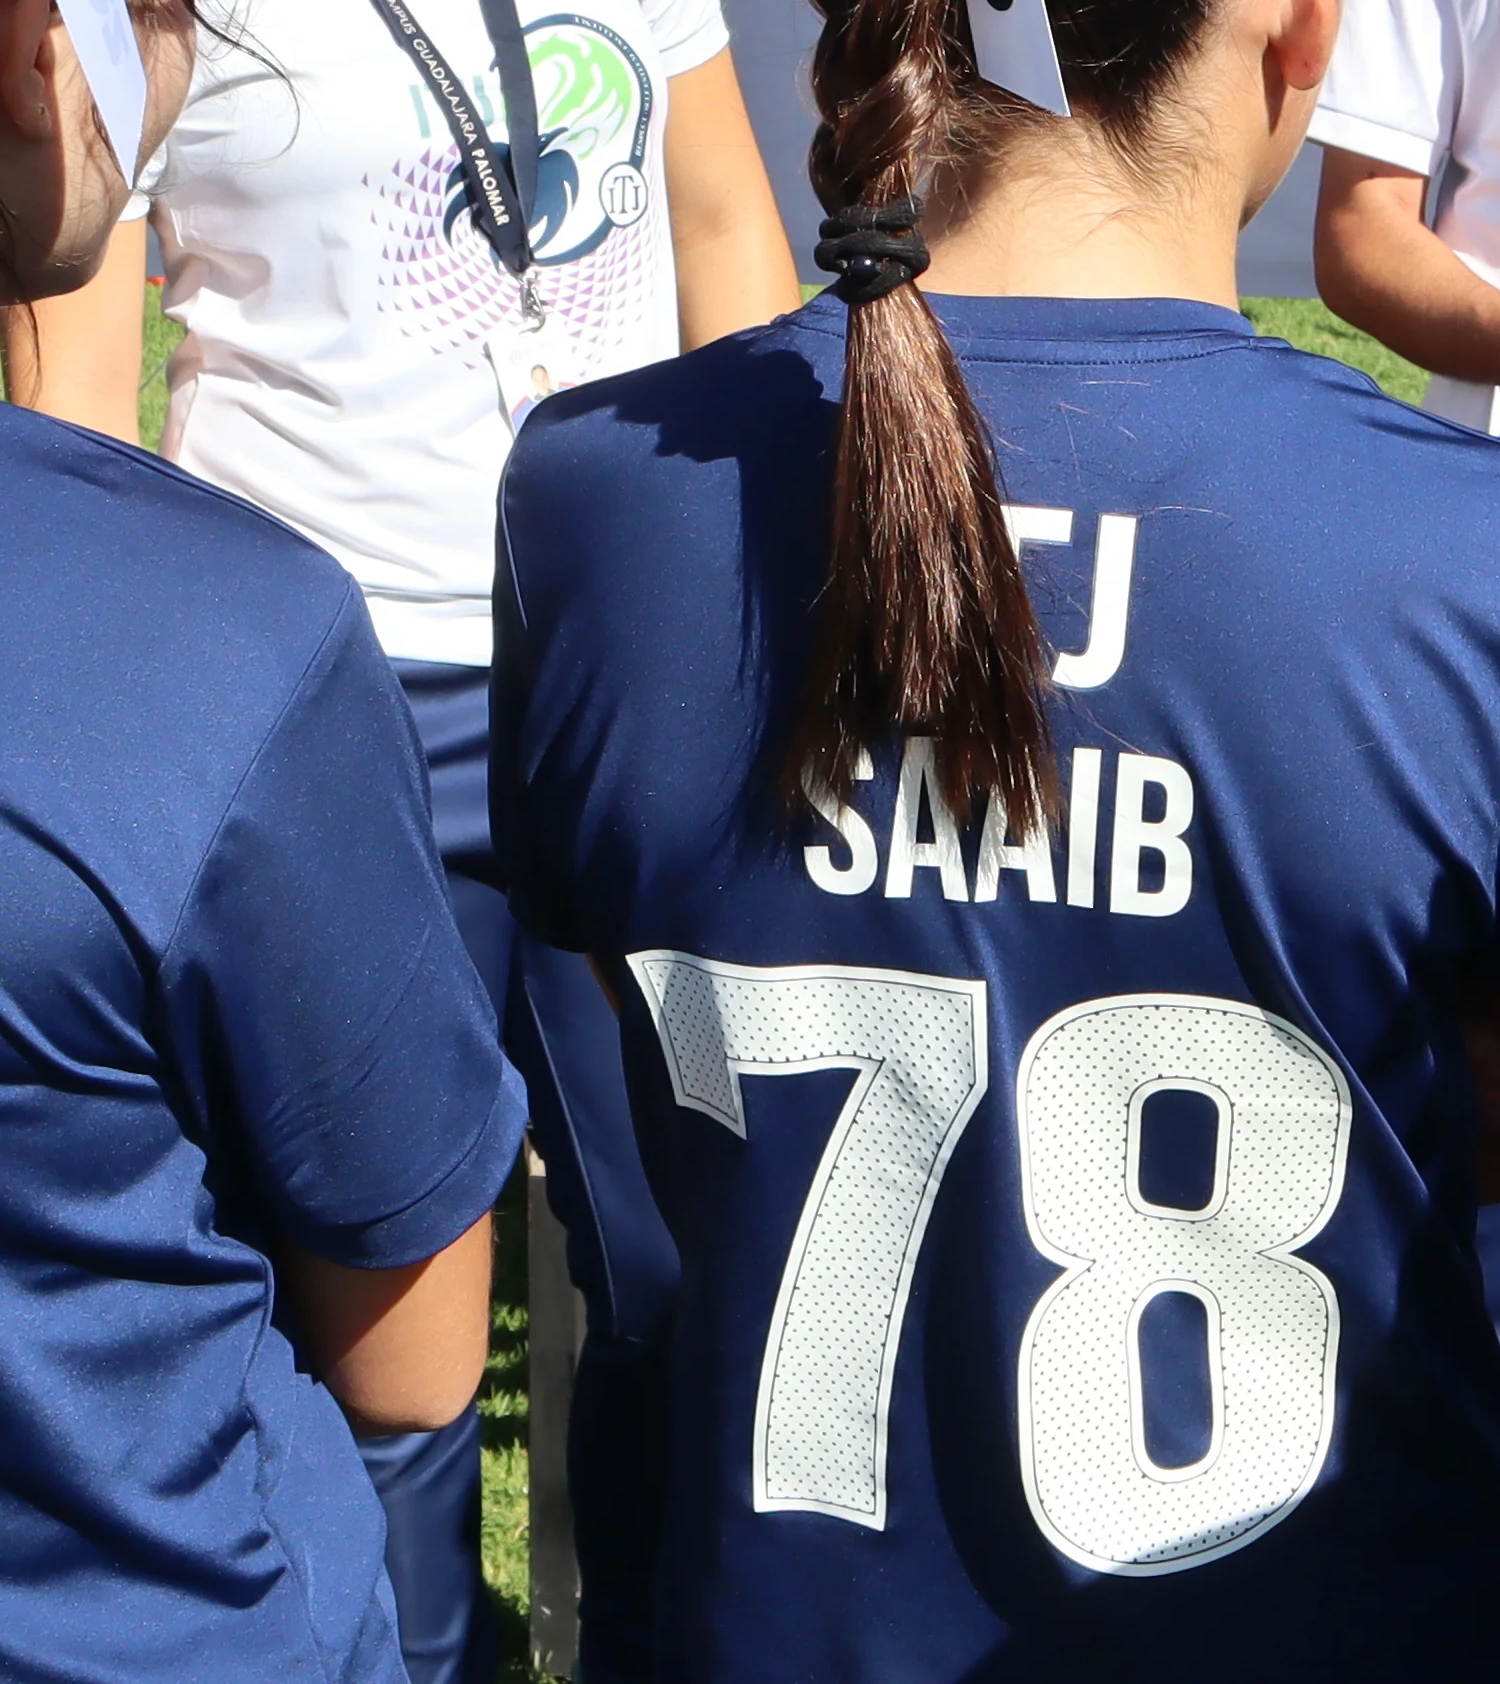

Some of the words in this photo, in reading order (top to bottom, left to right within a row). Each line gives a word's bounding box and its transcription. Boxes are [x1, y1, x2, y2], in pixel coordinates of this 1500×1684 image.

[412, 38, 479, 146] GUADALAJARA
[471, 148, 510, 227] PALOMAR
[608, 175, 642, 215] ITJ
[801, 734, 1197, 917] SAAIB
[625, 948, 1353, 1578] 78
